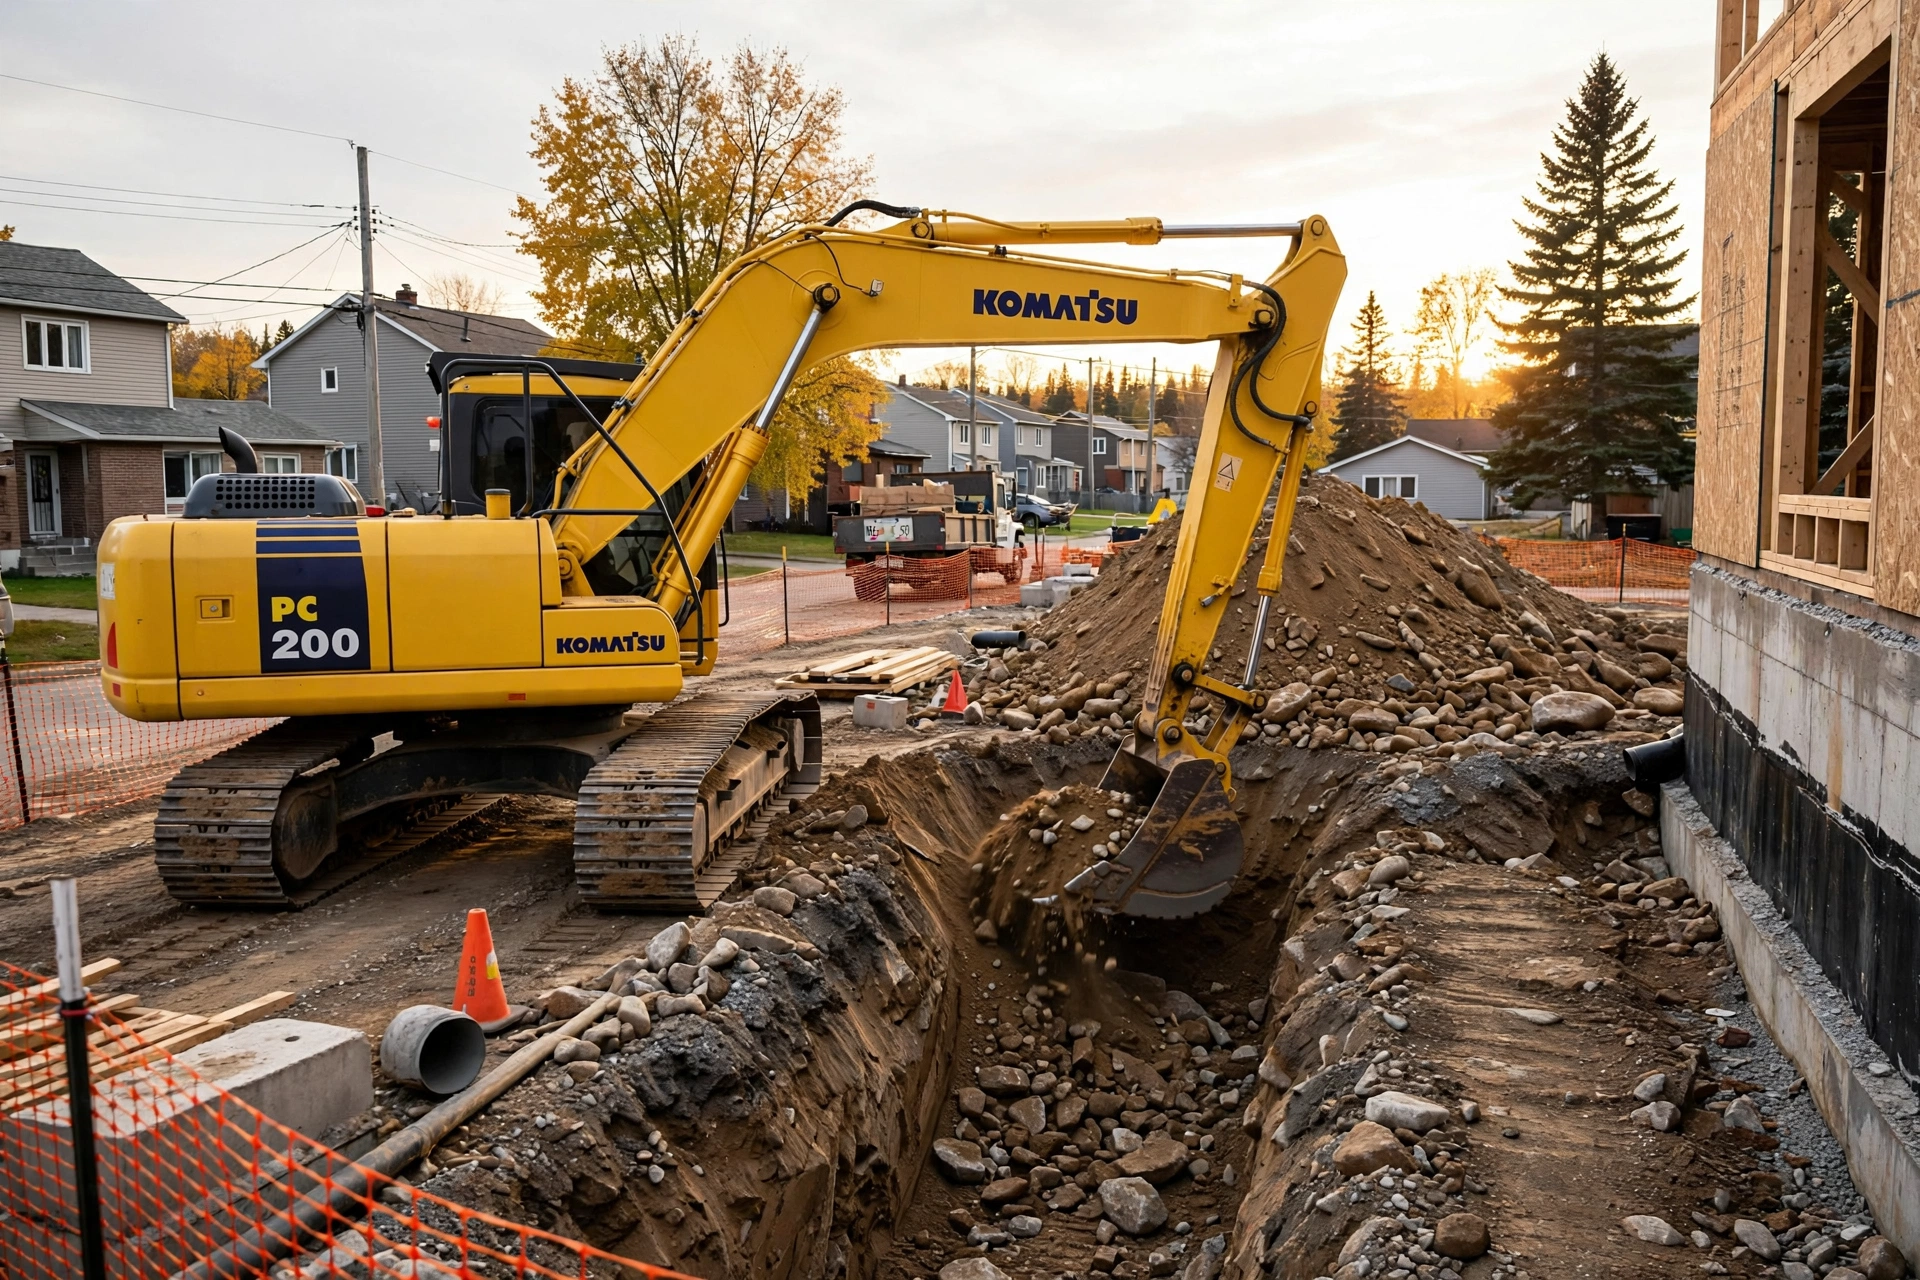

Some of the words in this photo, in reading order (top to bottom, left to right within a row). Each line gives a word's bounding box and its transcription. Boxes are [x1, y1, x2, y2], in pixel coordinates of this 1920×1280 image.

[973, 289, 1138, 326] KOMATSU
[271, 595, 318, 622] PC
[272, 628, 360, 659] 200
[556, 631, 665, 654] KOMATSU
